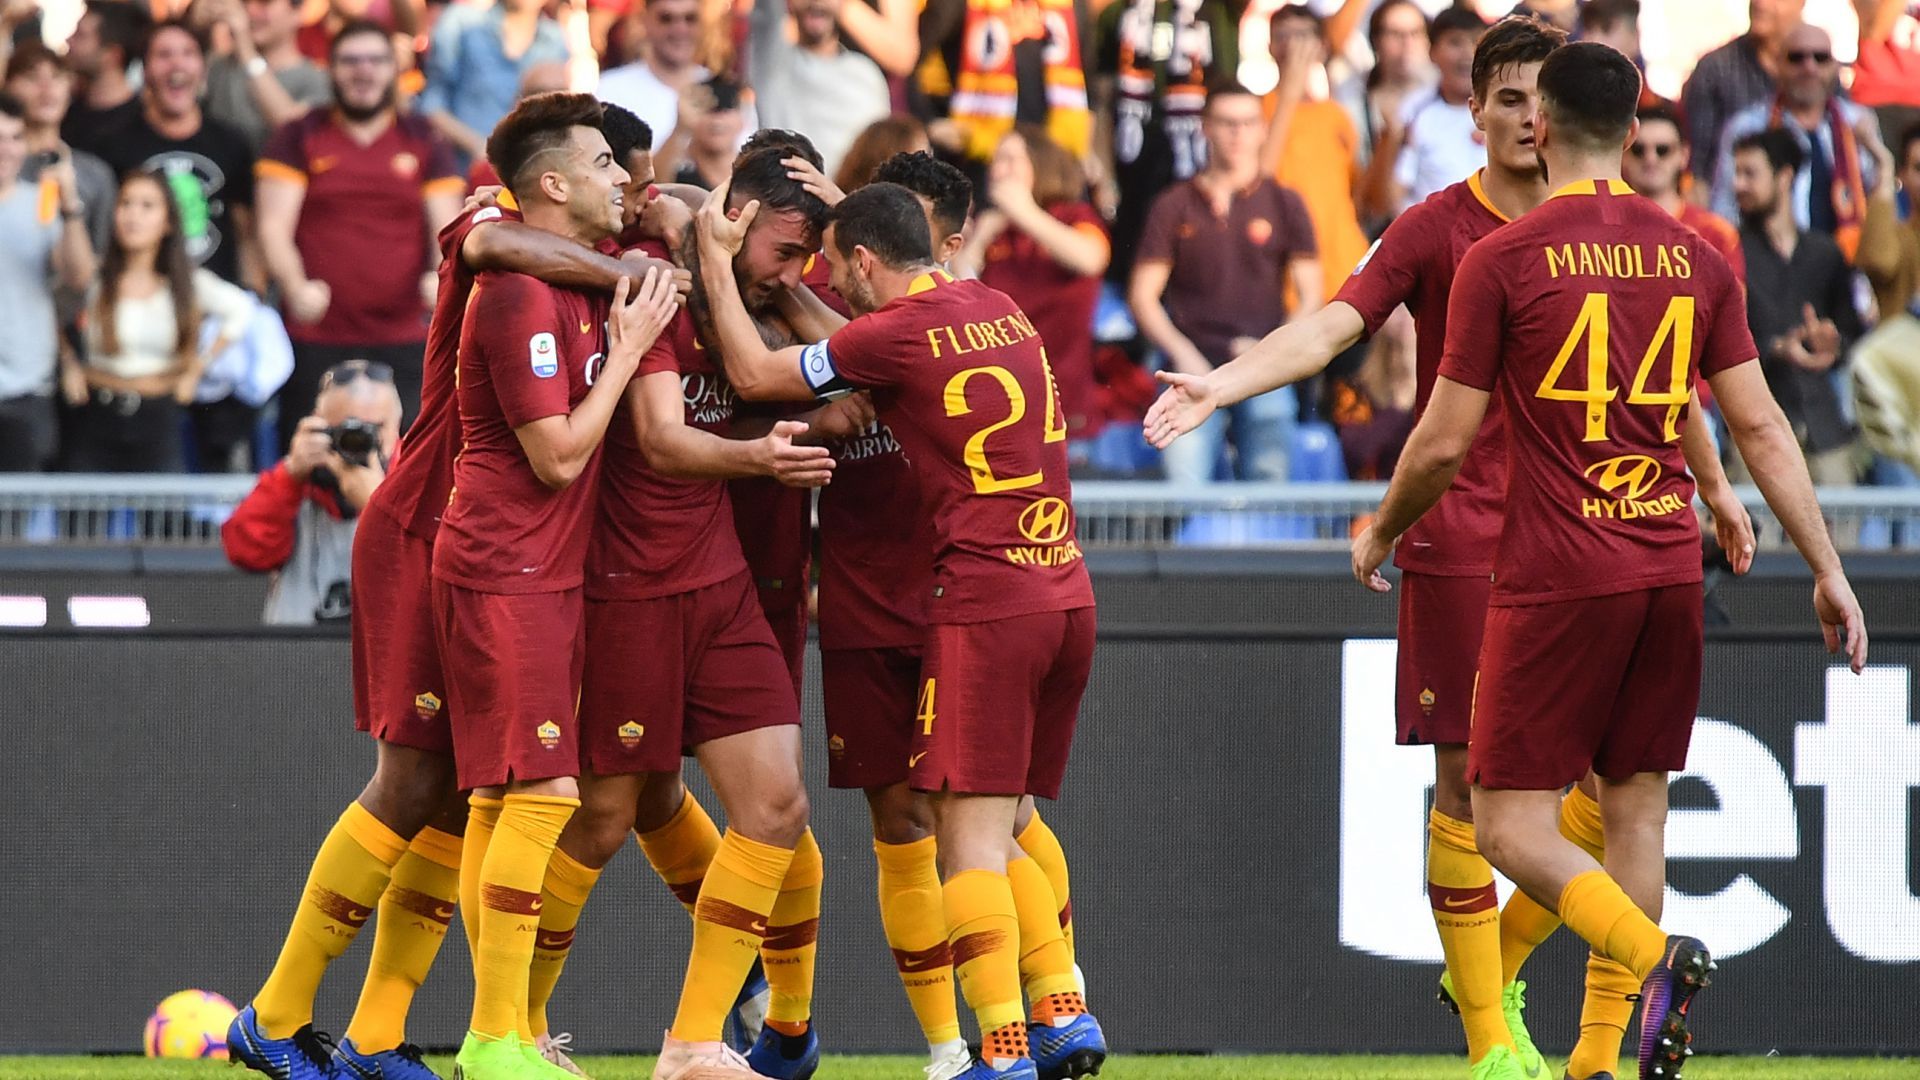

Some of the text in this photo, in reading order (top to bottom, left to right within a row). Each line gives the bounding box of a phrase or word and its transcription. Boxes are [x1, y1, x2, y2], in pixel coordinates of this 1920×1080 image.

[1545, 242, 1692, 280] MANOLAS
[1535, 292, 1695, 443] 44
[1582, 492, 1688, 519] HYUNDAI
[1005, 540, 1083, 566] HYUNDA
[916, 677, 937, 735] 4
